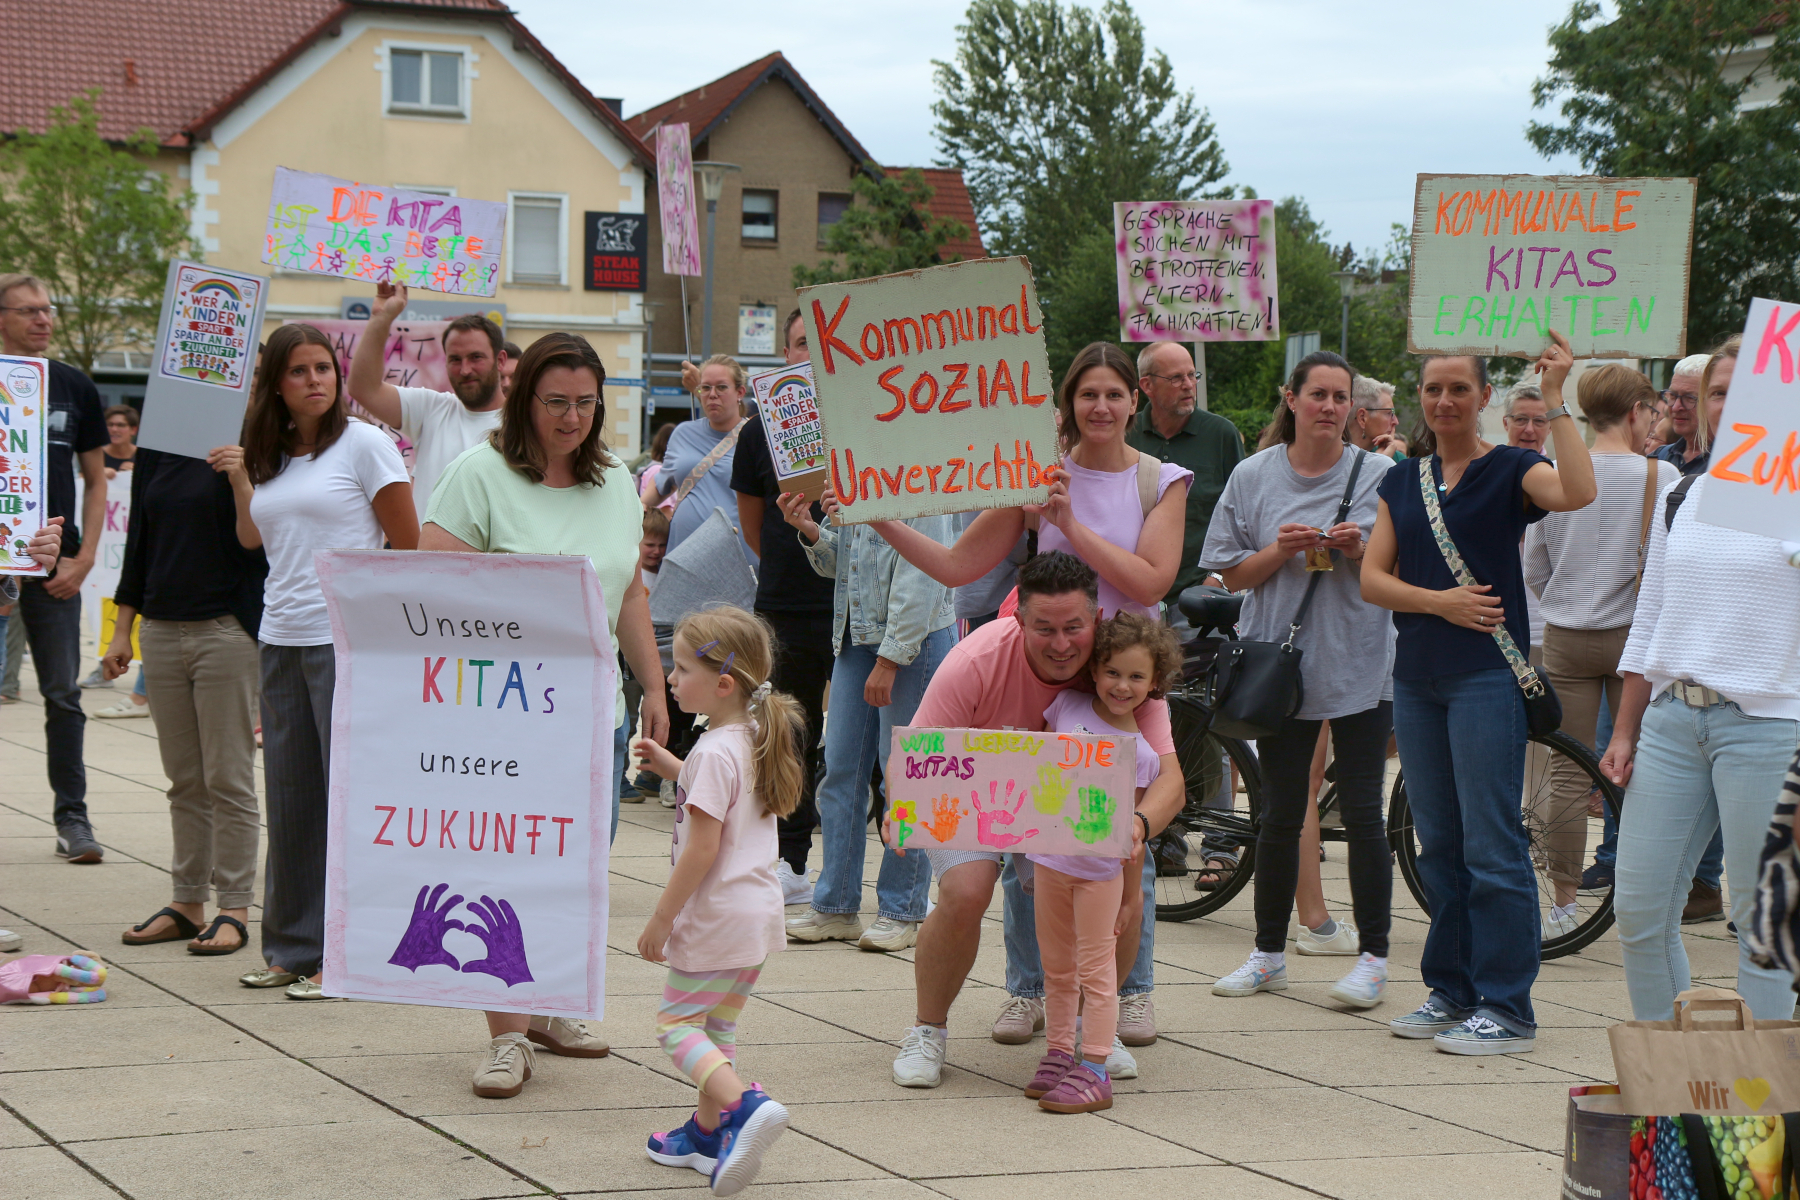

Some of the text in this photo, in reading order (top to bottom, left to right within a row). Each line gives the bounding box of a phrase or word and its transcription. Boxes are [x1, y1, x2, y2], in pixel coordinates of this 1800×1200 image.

[386, 197, 462, 236] KITA
[1123, 207, 1234, 231] GESPRÄCHE
[1434, 188, 1642, 237] KOMMUNALE
[273, 202, 483, 261] IST DAS BESTE
[1134, 234, 1260, 253] SUCHEN MIT
[593, 255, 640, 270] STEAK
[1485, 245, 1617, 293] KITAS
[593, 269, 640, 284] HOUSE
[191, 294, 239, 312] WER AN
[182, 305, 247, 328] KINDERN
[197, 322, 227, 335] SPART.
[174, 329, 244, 349] SPART AN DER
[811, 284, 1042, 375] Kommunal
[185, 342, 234, 357] ZUKUNFT!
[771, 387, 813, 407] WER AN
[874, 358, 1048, 422] SOZIAL
[773, 427, 798, 442] SPART
[801, 423, 813, 433] AN
[787, 414, 813, 427] SPART.
[786, 431, 822, 448] ZUKUNF
[830, 439, 1062, 507] Unverzichtba
[402, 602, 523, 640] Unsere
[421, 656, 555, 714] KITA's
[899, 731, 1116, 770] WIR LIEBEN DIE
[420, 751, 520, 778] unsere
[905, 756, 975, 780] KITAS
[372, 805, 574, 857] ZUKUNFT
[1687, 1080, 1730, 1111] Wir
